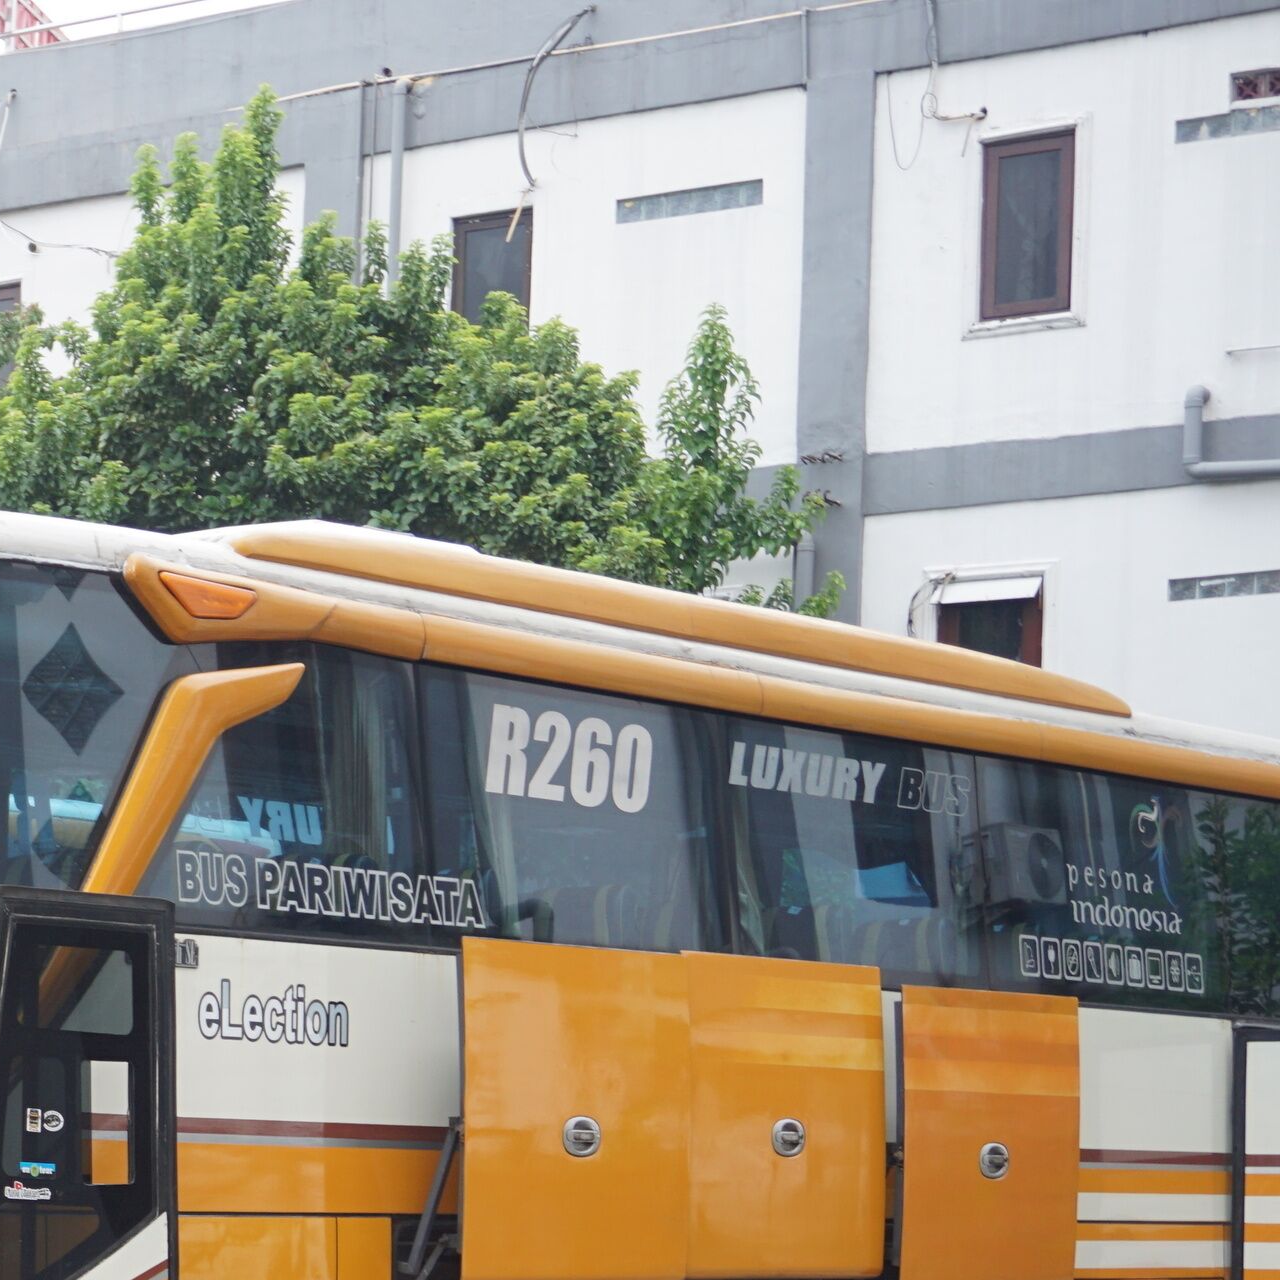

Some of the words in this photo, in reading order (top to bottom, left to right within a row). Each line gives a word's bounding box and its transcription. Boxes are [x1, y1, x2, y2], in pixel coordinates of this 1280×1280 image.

[485, 703, 653, 814] R260
[728, 741, 887, 804] LUXURY
[897, 767, 970, 816] BUS
[176, 850, 248, 907] BUS
[255, 858, 487, 929] PARIWISATA
[1066, 863, 1154, 895] pesona
[1071, 896, 1183, 935] indonesia
[198, 979, 348, 1047] eLection
